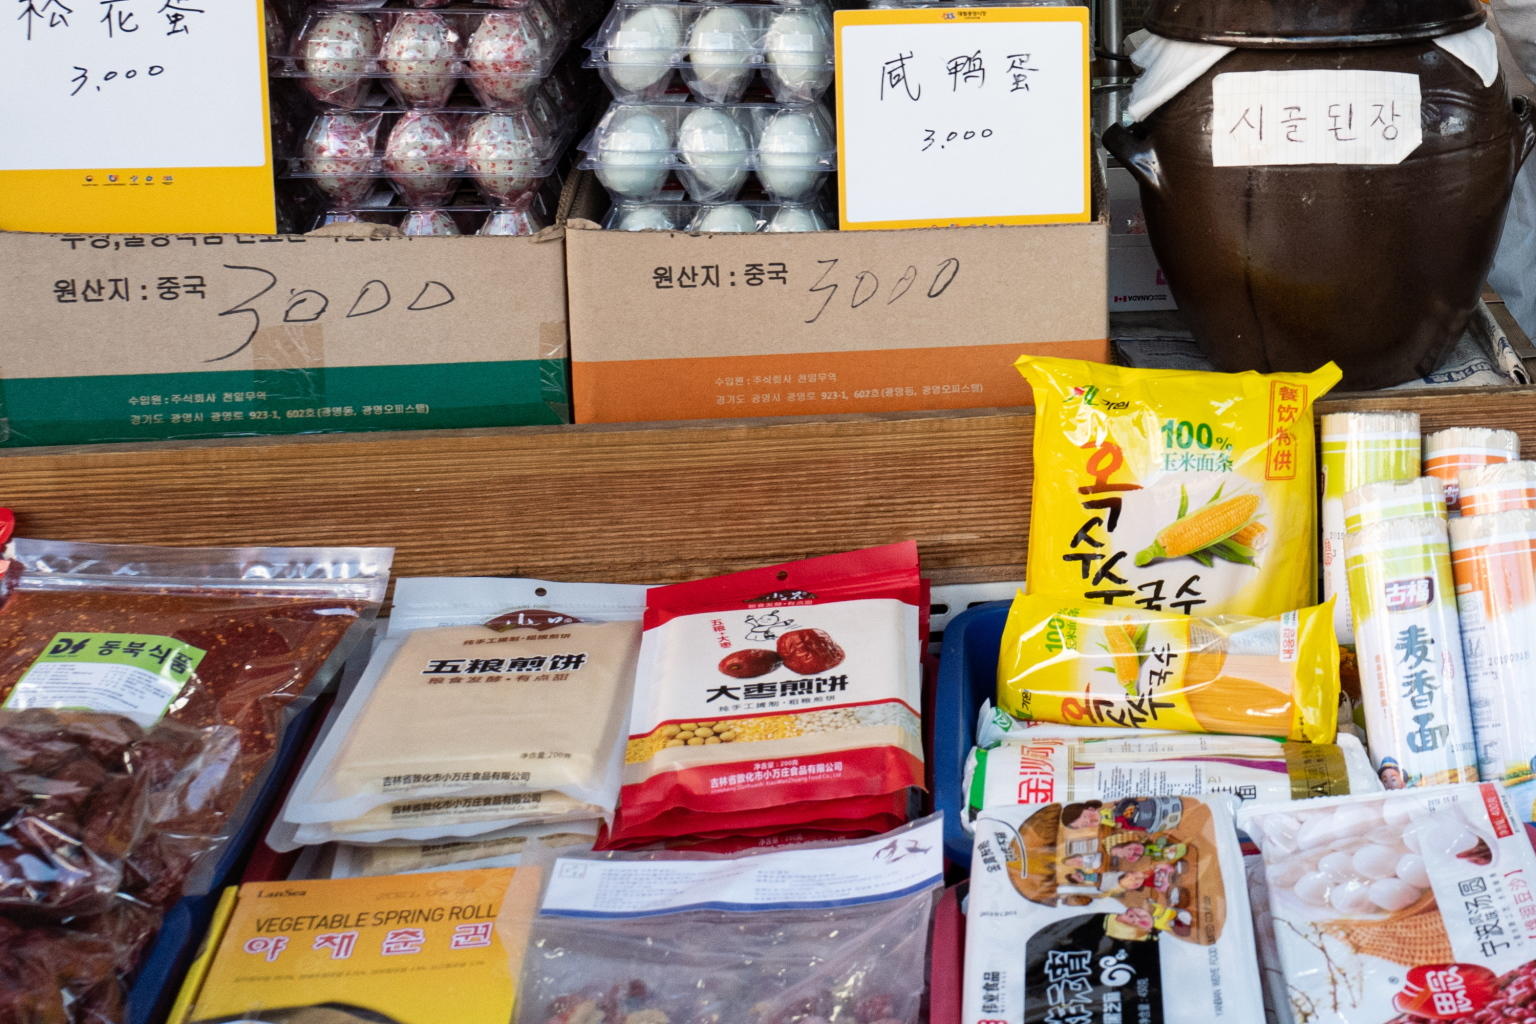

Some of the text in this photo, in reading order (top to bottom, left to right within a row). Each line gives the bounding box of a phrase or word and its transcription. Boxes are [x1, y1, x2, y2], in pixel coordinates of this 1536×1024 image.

[880, 49, 1040, 102] 咸鸭蛋
[156, 275, 207, 300] 중국
[743, 262, 789, 286] 중국
[804, 257, 960, 324] 3000
[202, 263, 456, 363] 3000
[1160, 418, 1233, 452] 100%
[1160, 451, 1234, 473] 玉米面条
[97, 639, 193, 675] 동북식품
[422, 652, 588, 675] 五粮煎饼
[1394, 624, 1450, 754] 麦香面
[255, 903, 498, 934] VEGETABLE SPRING ROLL
